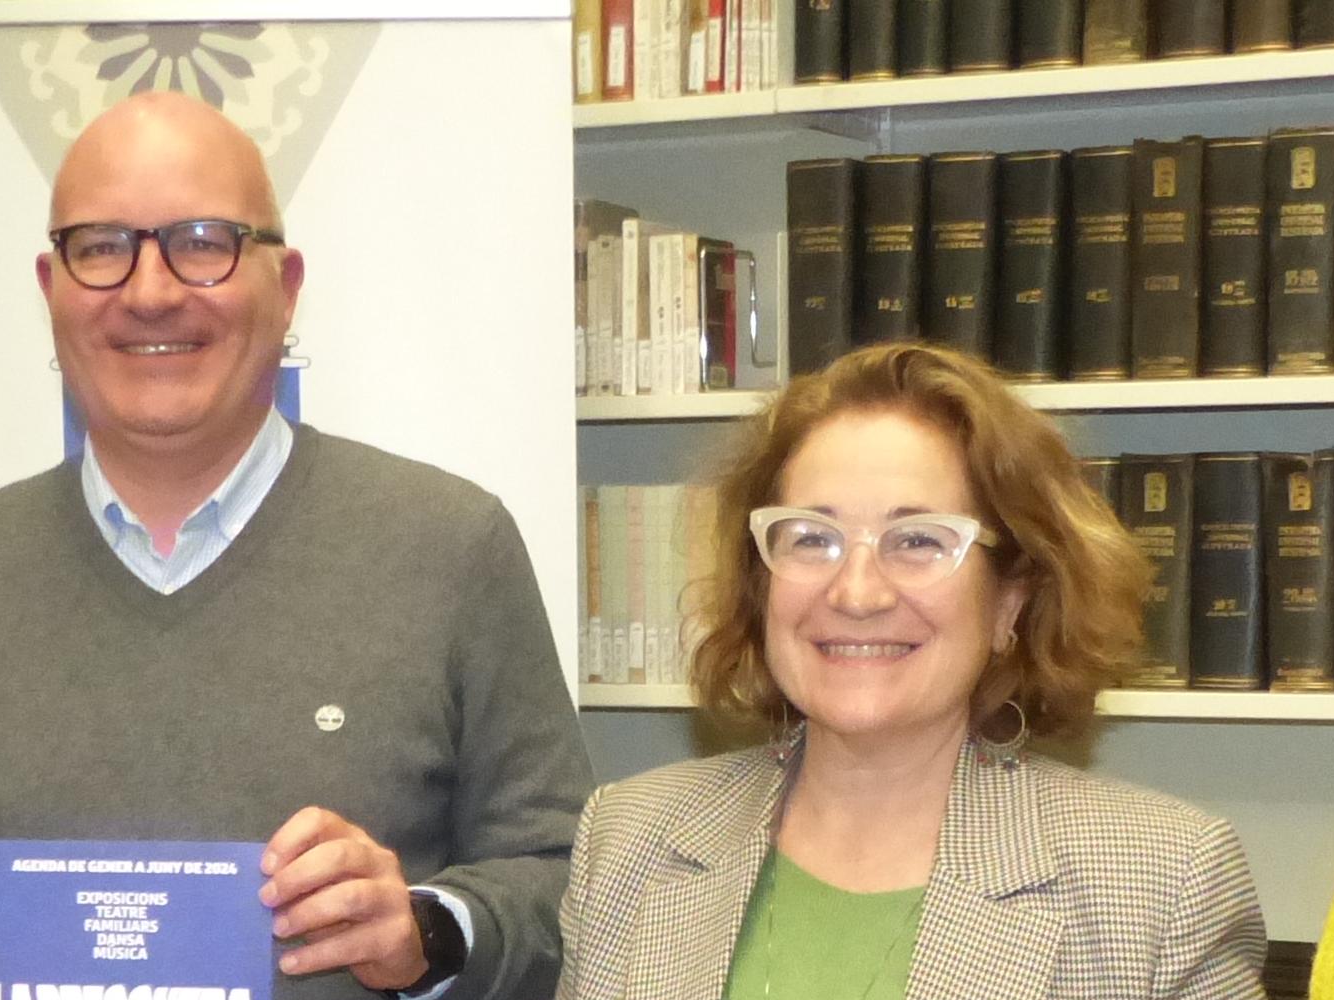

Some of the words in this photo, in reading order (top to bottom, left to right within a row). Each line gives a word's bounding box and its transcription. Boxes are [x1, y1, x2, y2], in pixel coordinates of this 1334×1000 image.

[12, 859, 66, 872] AGENDA
[68, 860, 86, 872] DE
[88, 860, 134, 873] GENER
[134, 861, 146, 873] A
[147, 862, 182, 874] JUNY
[184, 862, 203, 874] DE
[204, 862, 237, 875] 2024
[76, 892, 168, 905] EXPOSICIONS
[95, 906, 147, 919] TEATRE
[84, 919, 158, 933] FAMILIARS
[96, 933, 144, 946] DANSA
